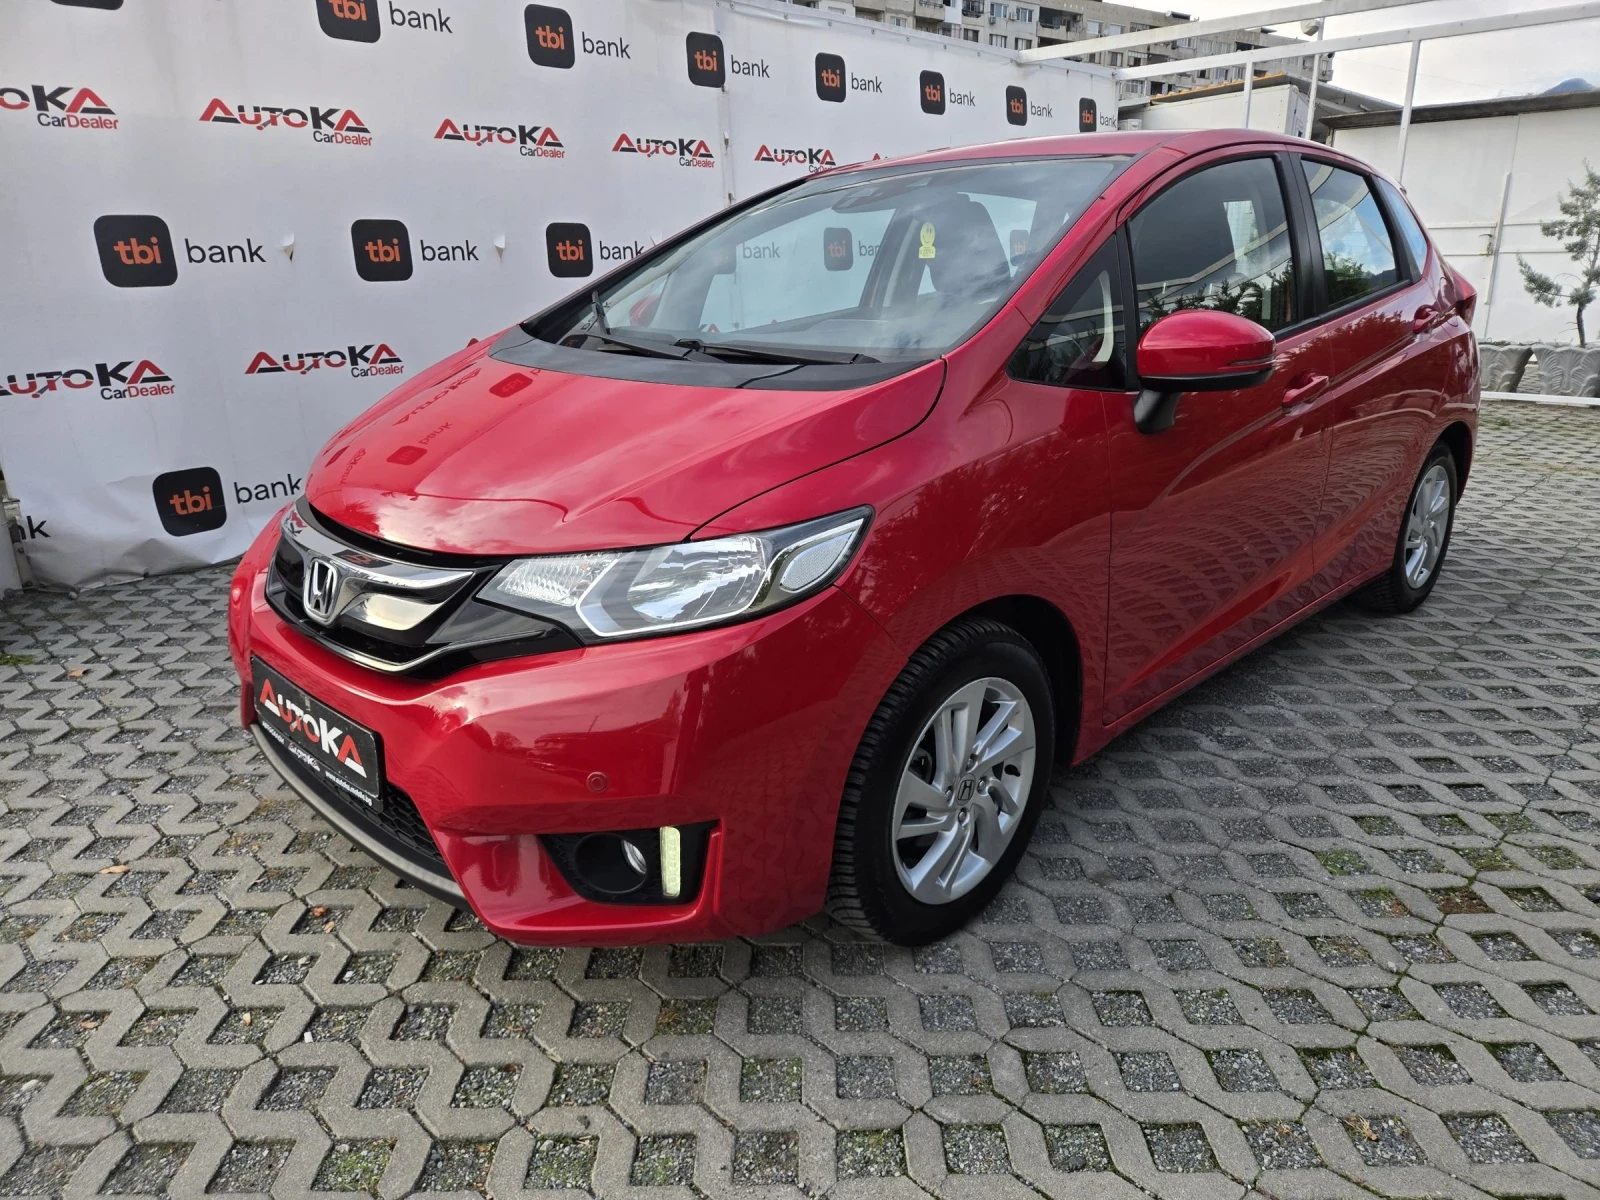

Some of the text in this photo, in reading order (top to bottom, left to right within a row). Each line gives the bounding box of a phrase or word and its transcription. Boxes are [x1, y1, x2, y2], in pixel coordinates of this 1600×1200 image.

[388, 1, 453, 33] bank
[535, 26, 631, 59] tbi bank
[695, 51, 770, 79] tbi bank
[821, 69, 883, 94] tbi bank
[0, 85, 116, 115] OKA
[925, 86, 976, 107] tbi bank
[1010, 98, 1053, 118] tbi bank
[37, 113, 119, 130] CarDealer
[200, 98, 371, 133] AUTOKA
[1082, 109, 1117, 129] tbi bank
[313, 131, 373, 146] CarDealer
[434, 118, 564, 147] AUTOKA
[520, 145, 565, 159] CarDealer
[612, 133, 714, 158] AUTOKA
[754, 144, 836, 166] AUTOKA
[679, 157, 715, 168] CarDealer
[114, 236, 267, 265] tbi bank
[365, 238, 479, 263] tbi bank
[556, 239, 644, 261] tbi bank
[742, 242, 781, 260] bank
[829, 240, 880, 258] tbi ban
[245, 343, 403, 375] AUTOKA
[351, 364, 405, 378] CarDealer
[100, 383, 175, 400] CarDealer
[169, 473, 303, 516] tbi bank
[259, 679, 367, 778] AUTOKA
